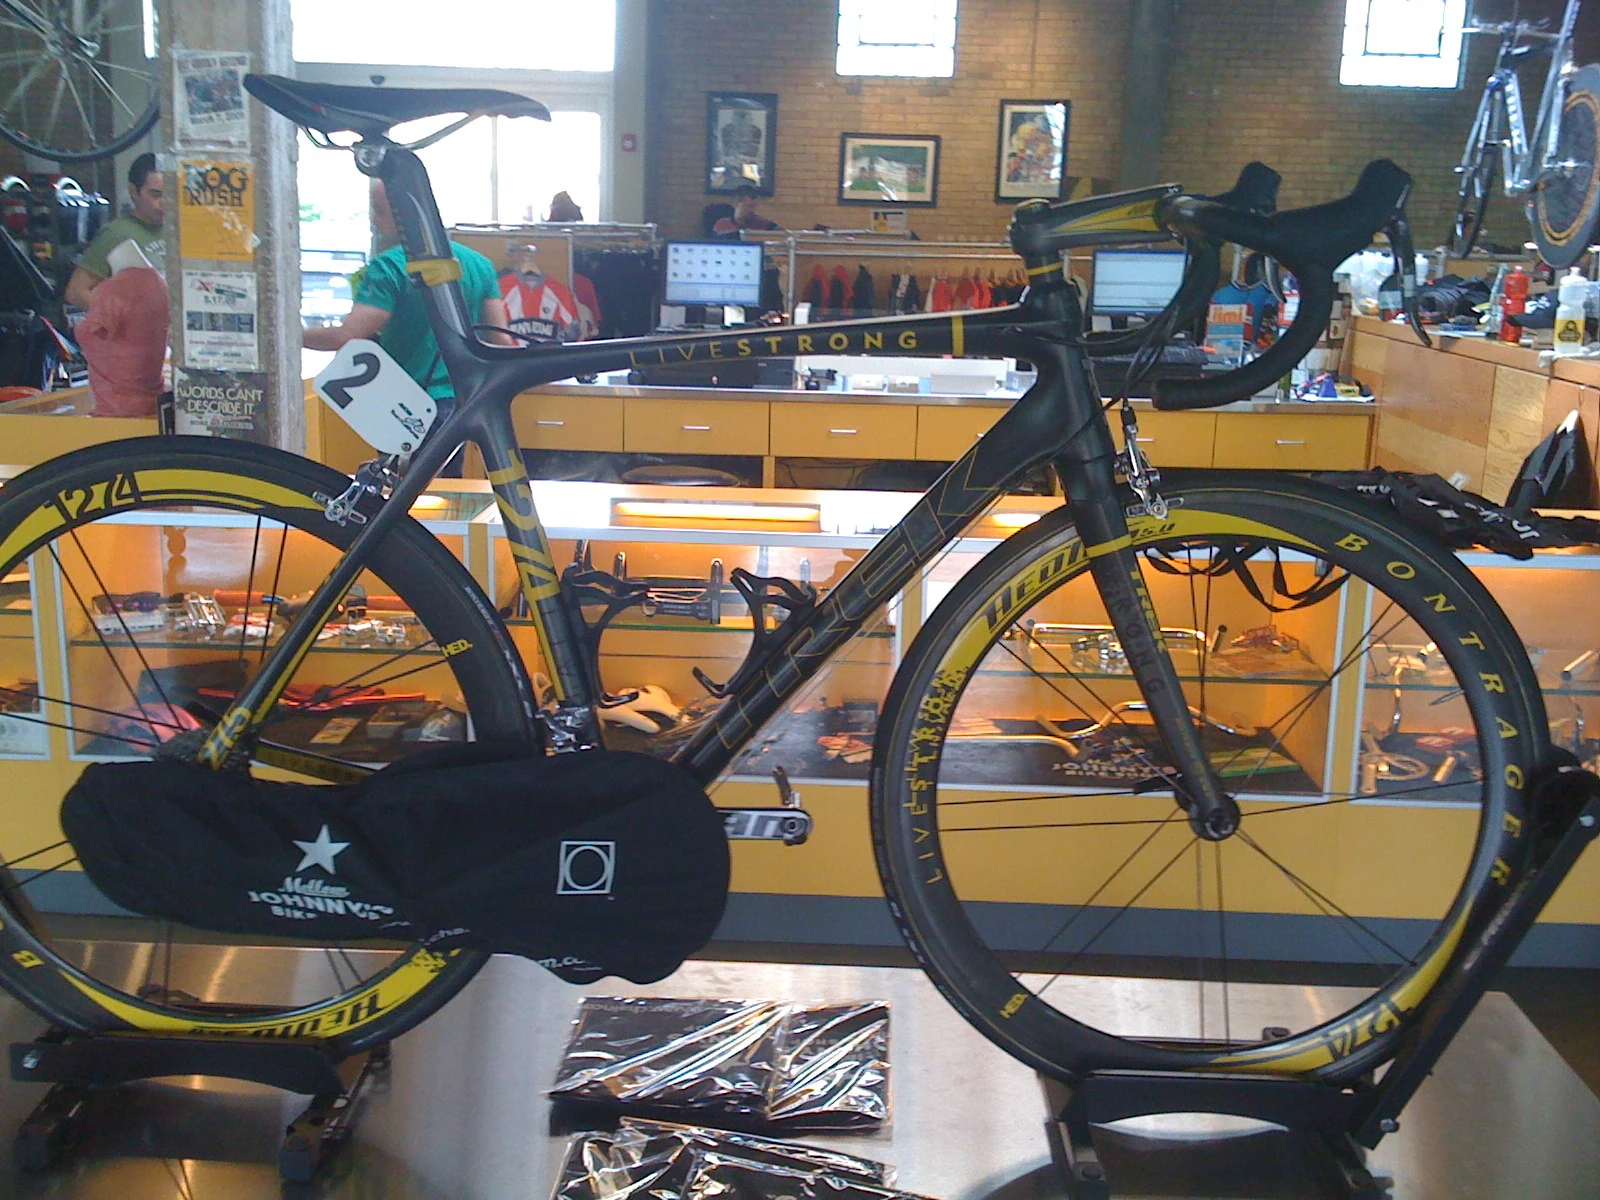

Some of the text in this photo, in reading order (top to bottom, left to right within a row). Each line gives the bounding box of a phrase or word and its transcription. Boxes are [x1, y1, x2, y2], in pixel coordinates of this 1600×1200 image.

[628, 329, 918, 368] LIVESTRONG
[179, 386, 224, 399] WORDS
[321, 352, 382, 410] 2
[187, 400, 241, 415] DESCRIBE
[1333, 532, 1526, 886] BONTRAGER
